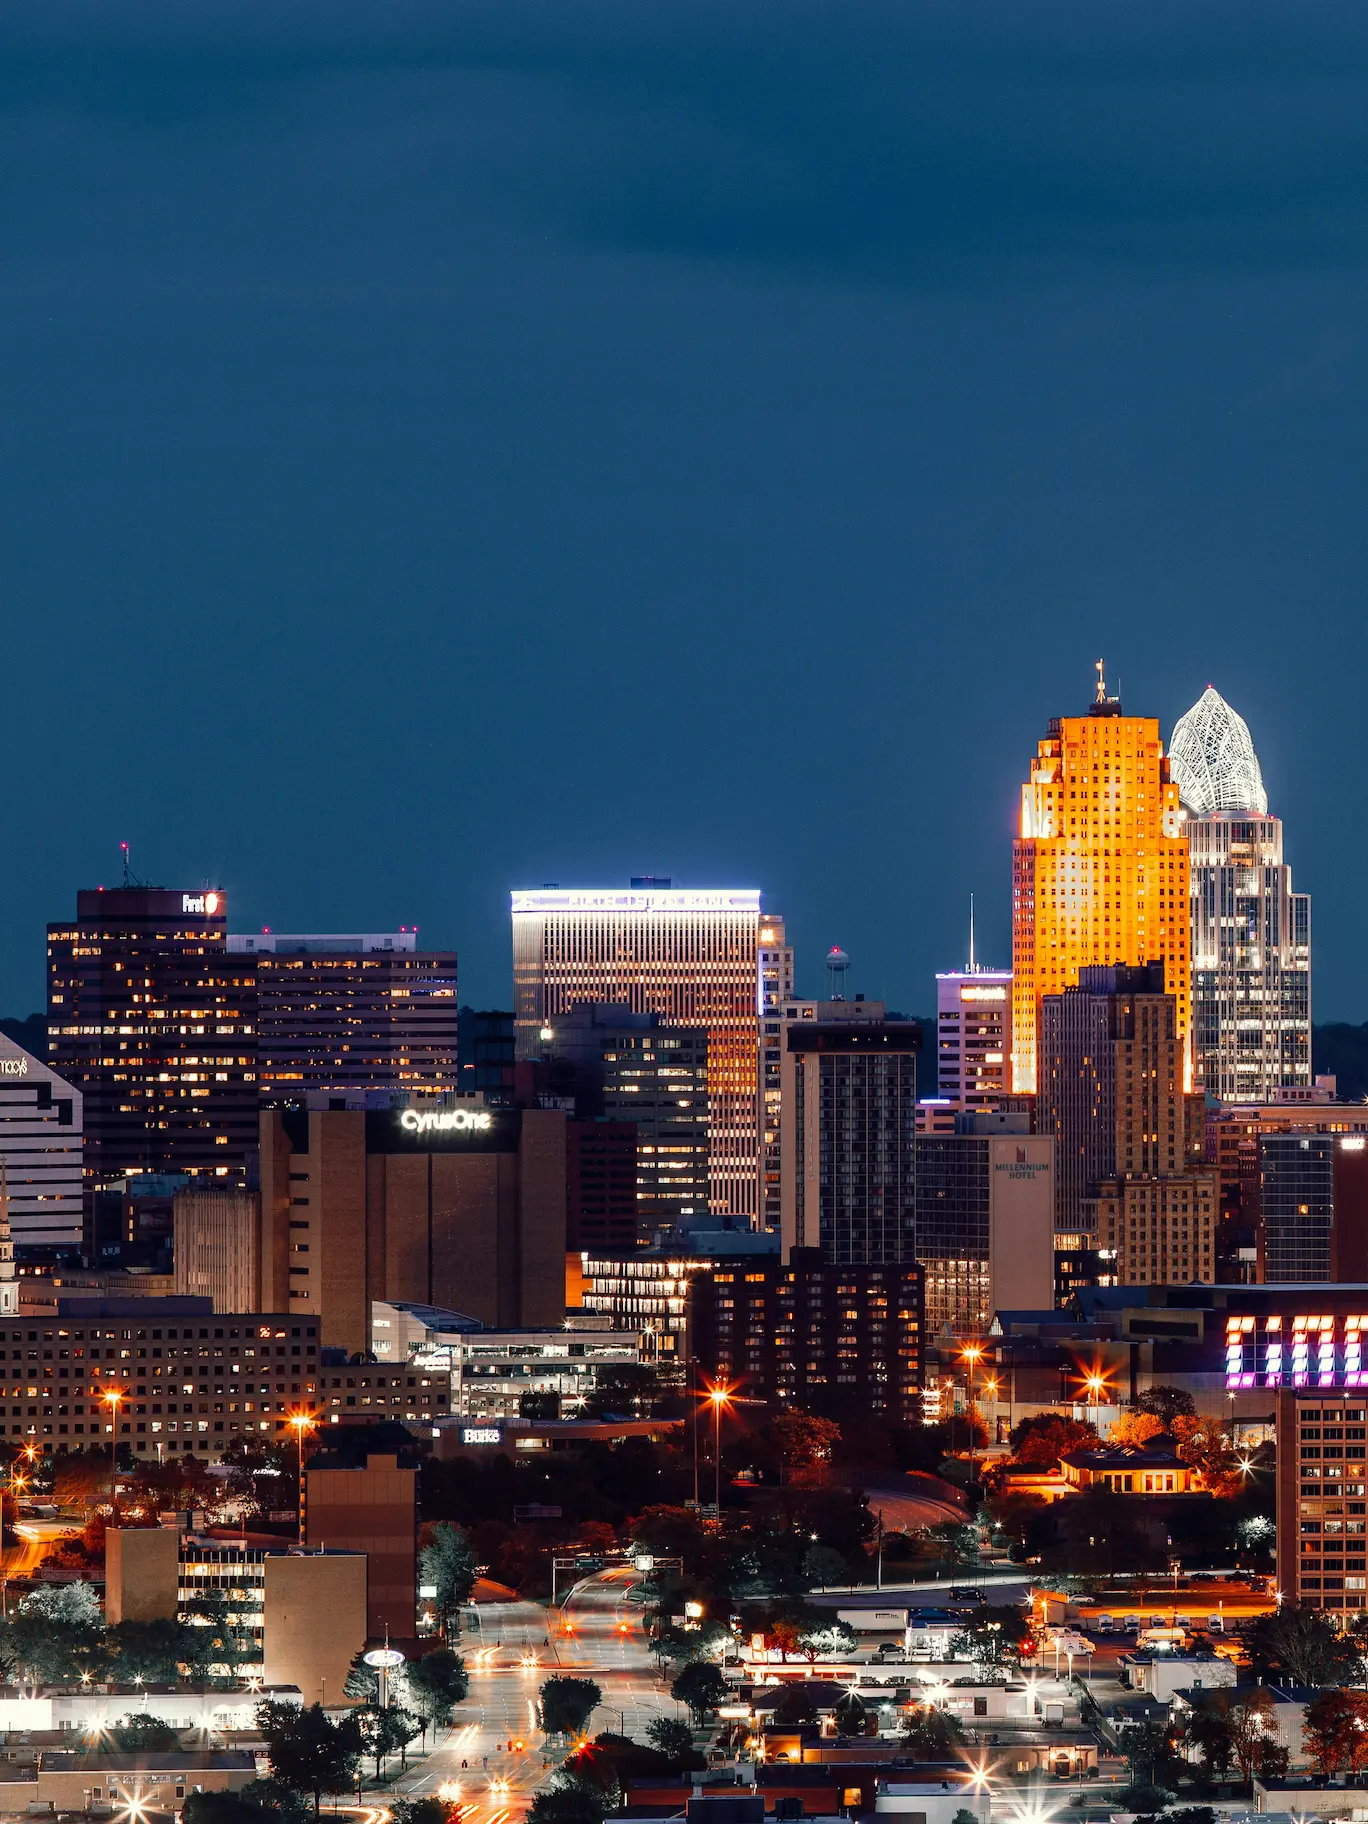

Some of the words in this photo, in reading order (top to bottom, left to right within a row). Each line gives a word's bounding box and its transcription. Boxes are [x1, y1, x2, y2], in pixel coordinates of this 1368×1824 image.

[182, 894, 205, 912] First
[401, 1109, 490, 1133] CyrusOne
[464, 1428, 500, 1443] Burke
